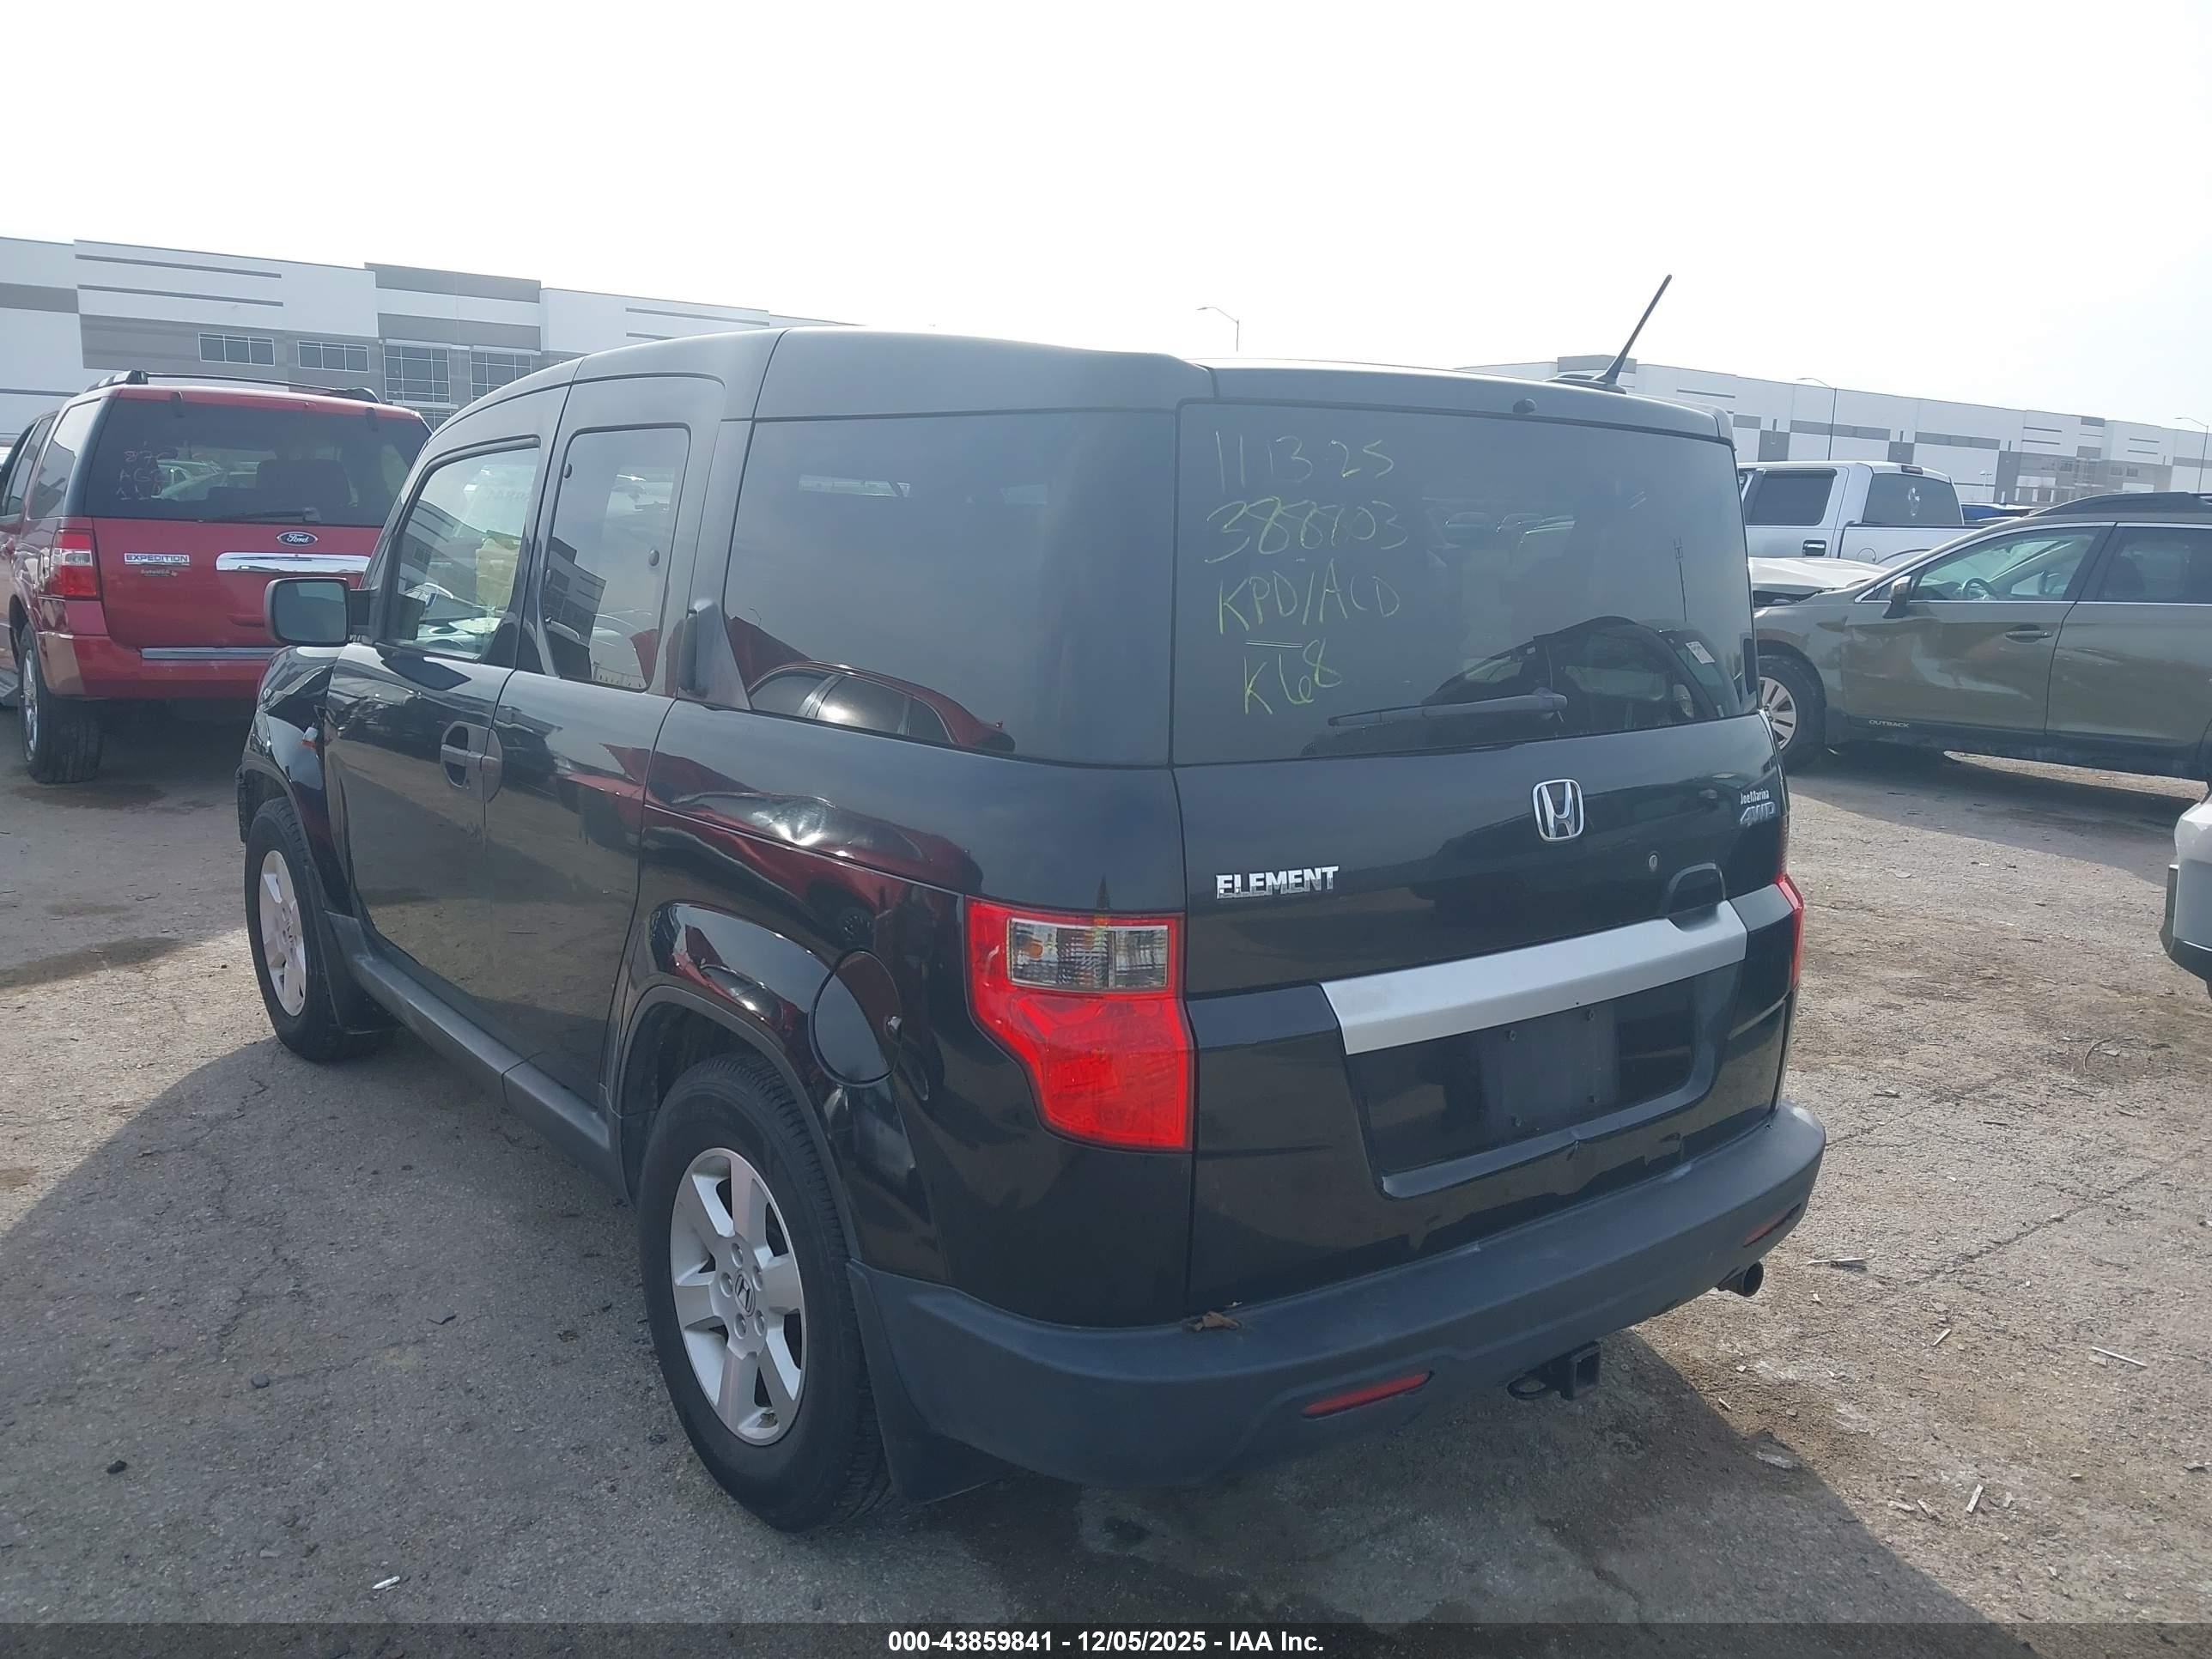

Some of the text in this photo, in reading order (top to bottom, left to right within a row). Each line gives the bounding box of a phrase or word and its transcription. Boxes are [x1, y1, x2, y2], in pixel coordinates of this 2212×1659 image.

[286, 533, 309, 544] Ford
[126, 554, 188, 562] EXPEDITION
[1869, 720, 1910, 728] OUTBACK
[1740, 801, 1775, 826] 4WD
[1215, 866, 1340, 900] ELEMENT
